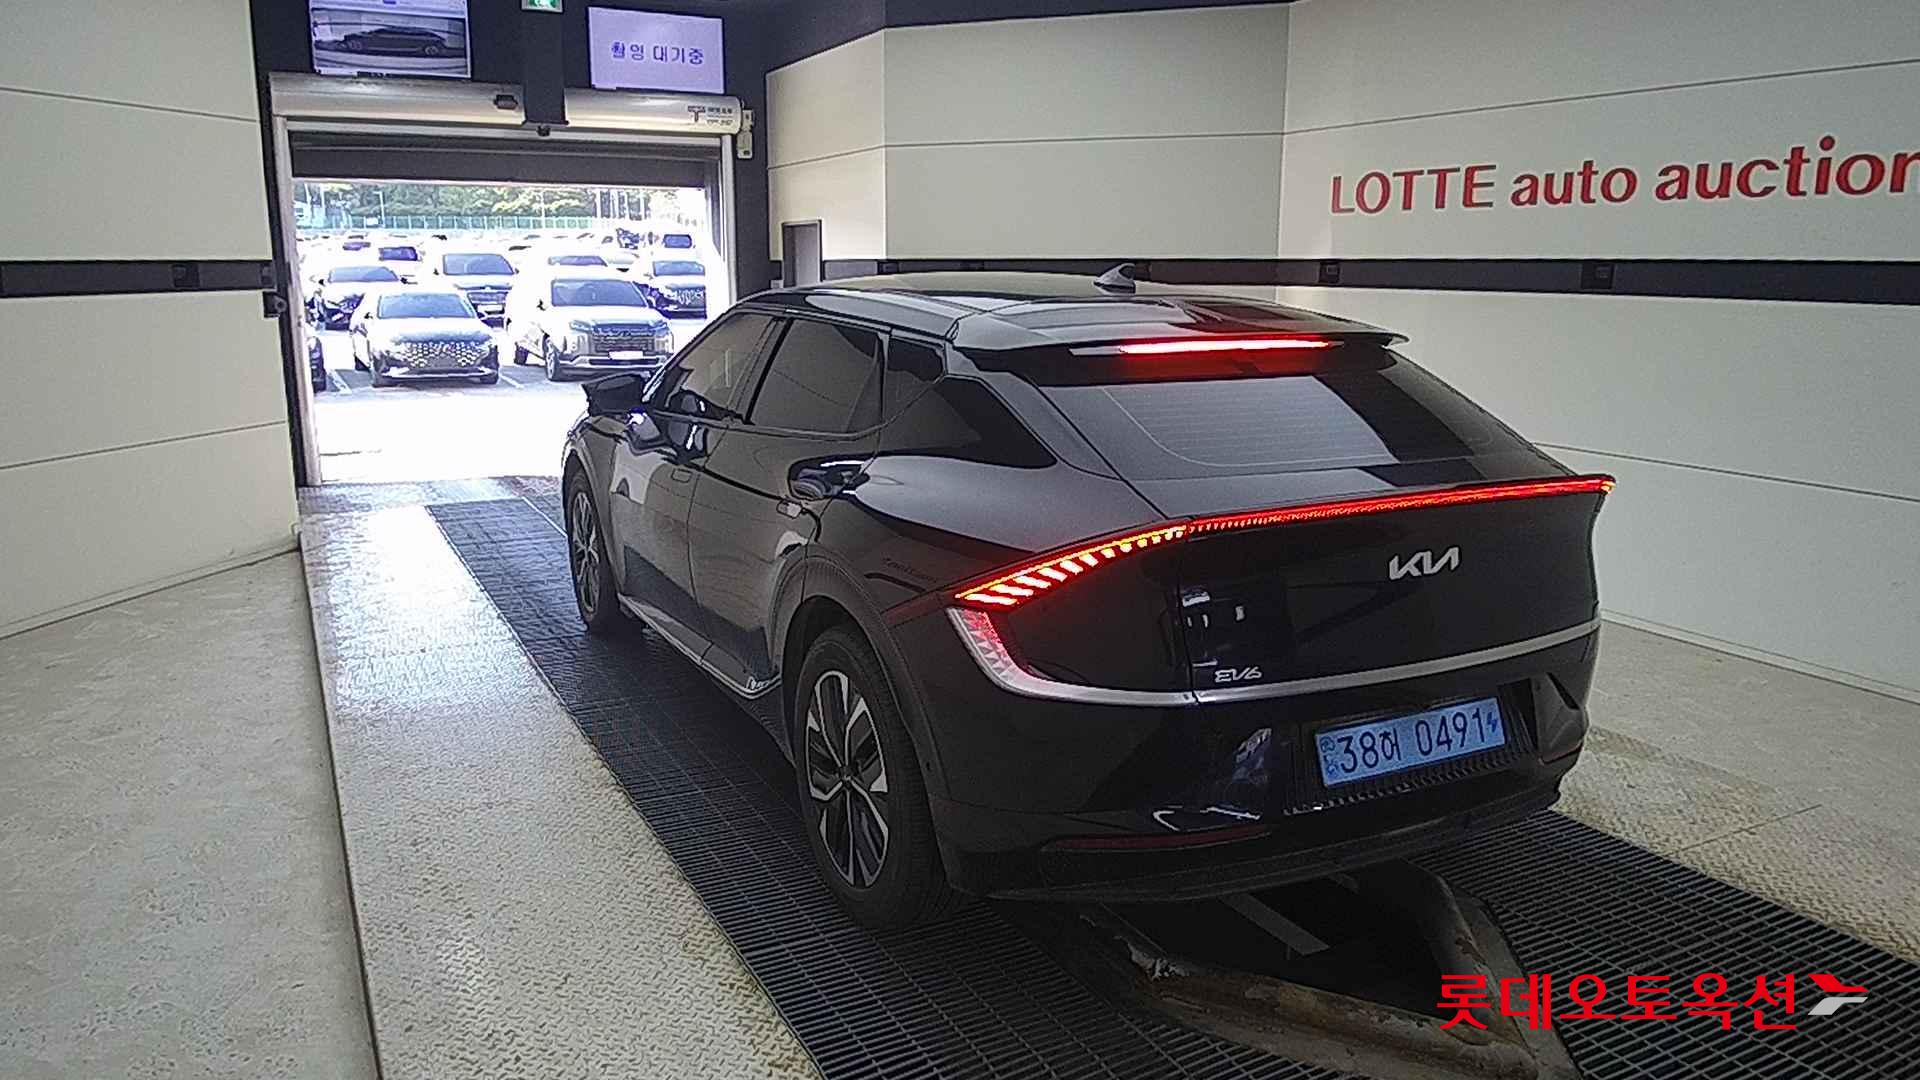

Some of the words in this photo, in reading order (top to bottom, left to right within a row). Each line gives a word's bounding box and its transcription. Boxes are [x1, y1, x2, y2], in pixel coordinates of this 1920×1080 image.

[652, 44, 704, 66] 대기중
[1331, 164, 1497, 215] LOTTE
[1510, 159, 1638, 206] auto
[1389, 547, 1460, 580] KIA
[1214, 666, 1262, 683] EV6
[1337, 727, 1401, 773] 38허
[1415, 708, 1486, 756] 0491
